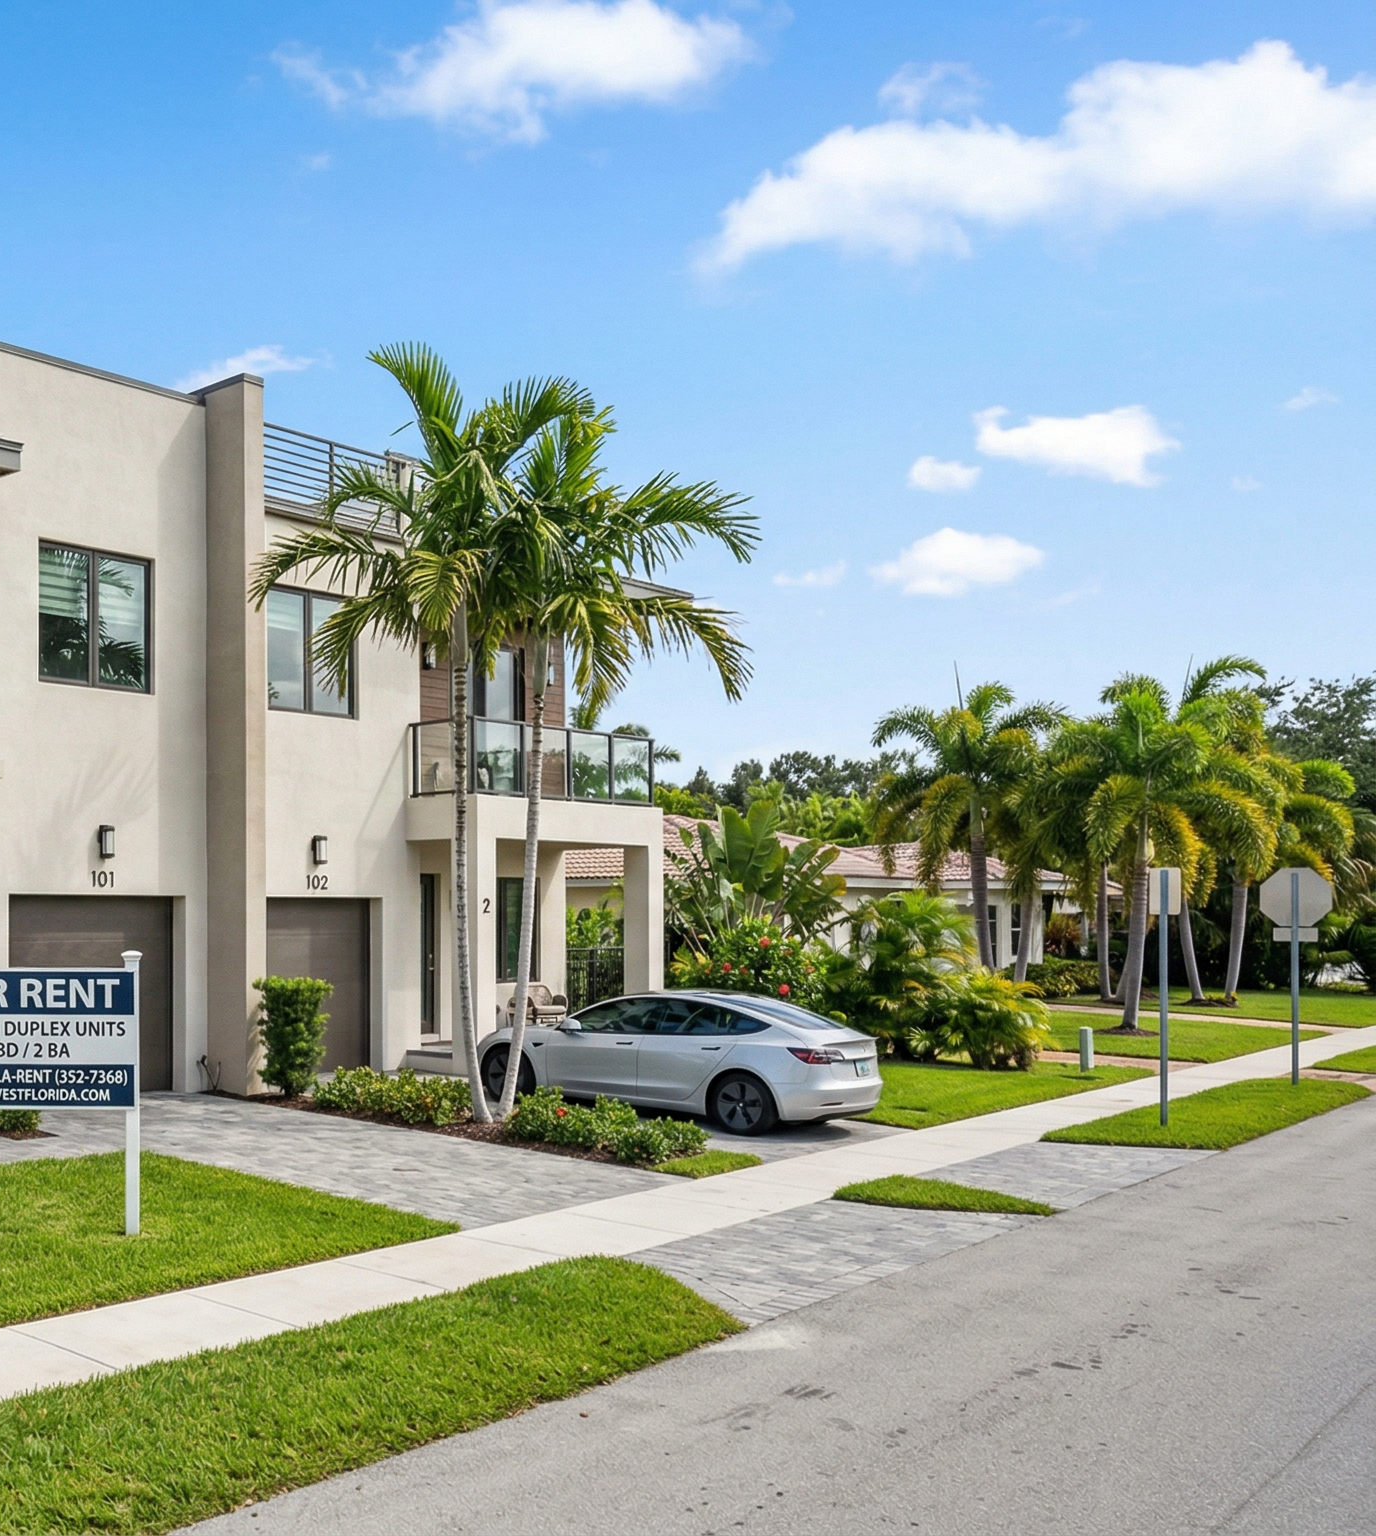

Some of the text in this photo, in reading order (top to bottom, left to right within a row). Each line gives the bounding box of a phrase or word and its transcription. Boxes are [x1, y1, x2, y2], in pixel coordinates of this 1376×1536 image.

[91, 870, 114, 888] 101
[306, 874, 329, 890] 102
[482, 897, 491, 914] 2
[20, 978, 120, 1008] RENT
[4, 1021, 71, 1037] DUPLEX
[75, 1021, 126, 1037] UNITS
[22, 1042, 30, 1059] /
[33, 1043, 43, 1058] 2
[48, 1043, 71, 1058] BA
